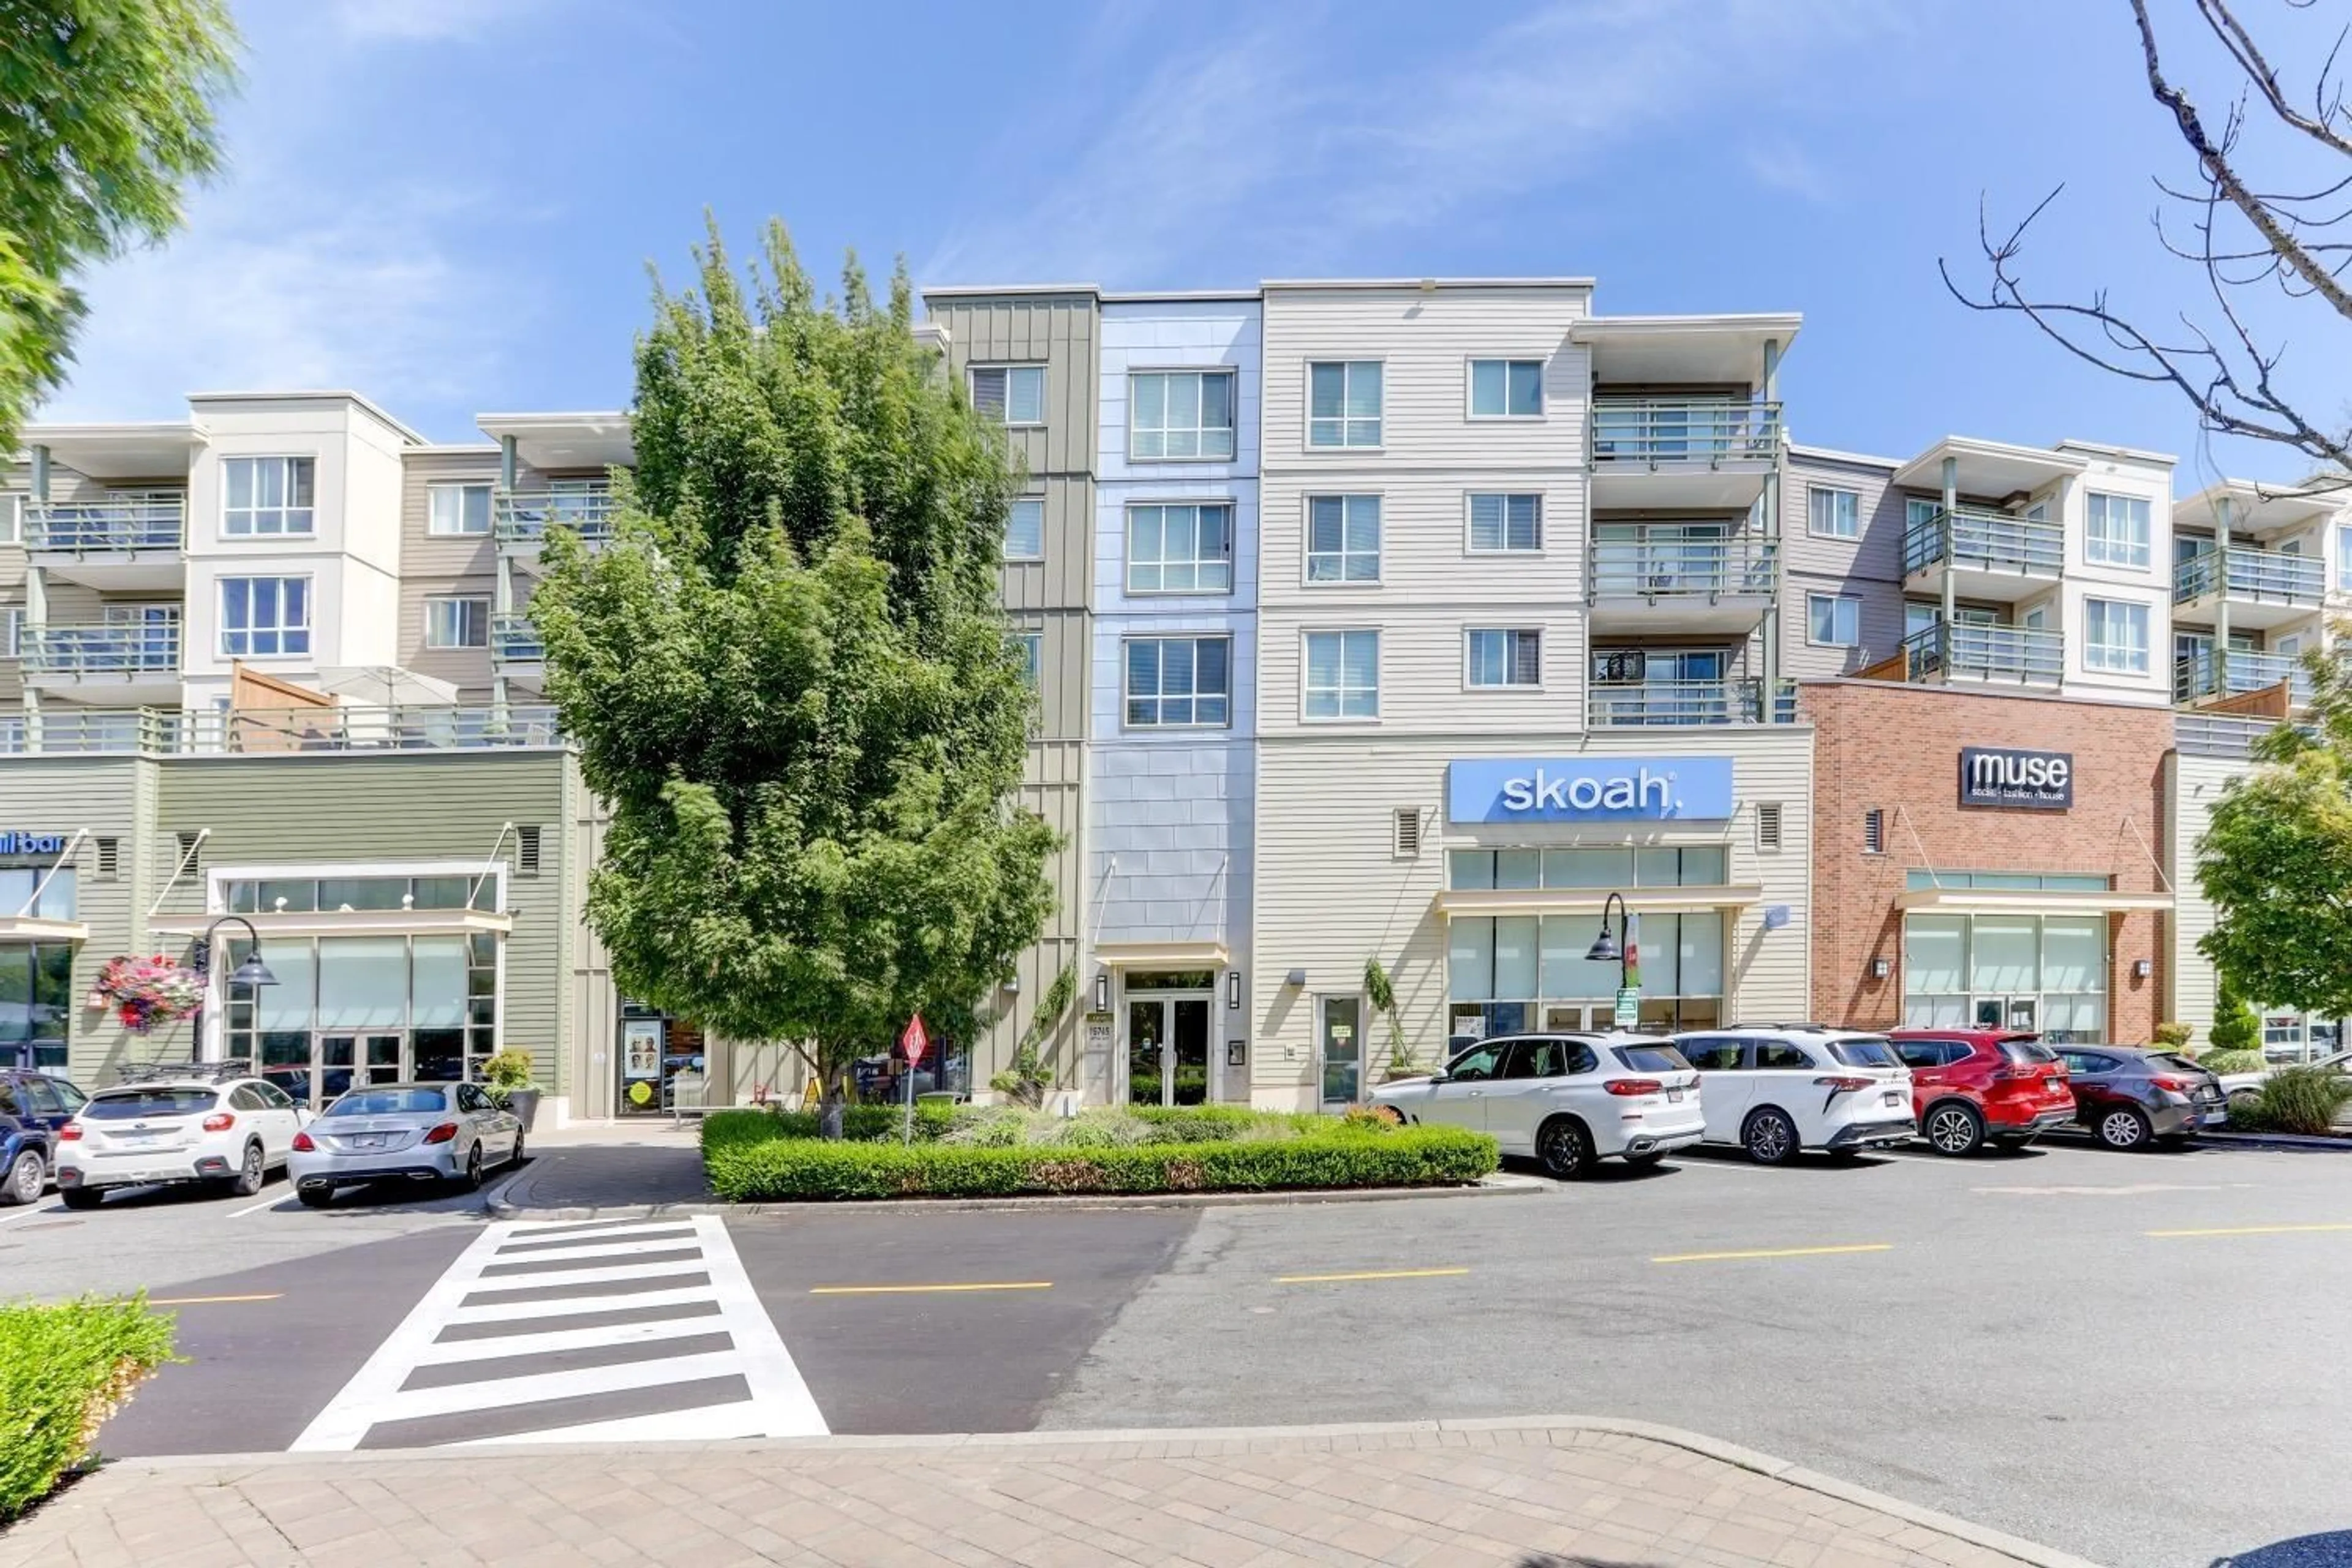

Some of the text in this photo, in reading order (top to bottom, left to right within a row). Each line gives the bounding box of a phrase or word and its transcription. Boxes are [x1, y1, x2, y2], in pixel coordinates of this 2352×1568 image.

[1973, 753, 2068, 788] muse
[2040, 788, 2065, 801] house
[22, 831, 62, 854] bar
